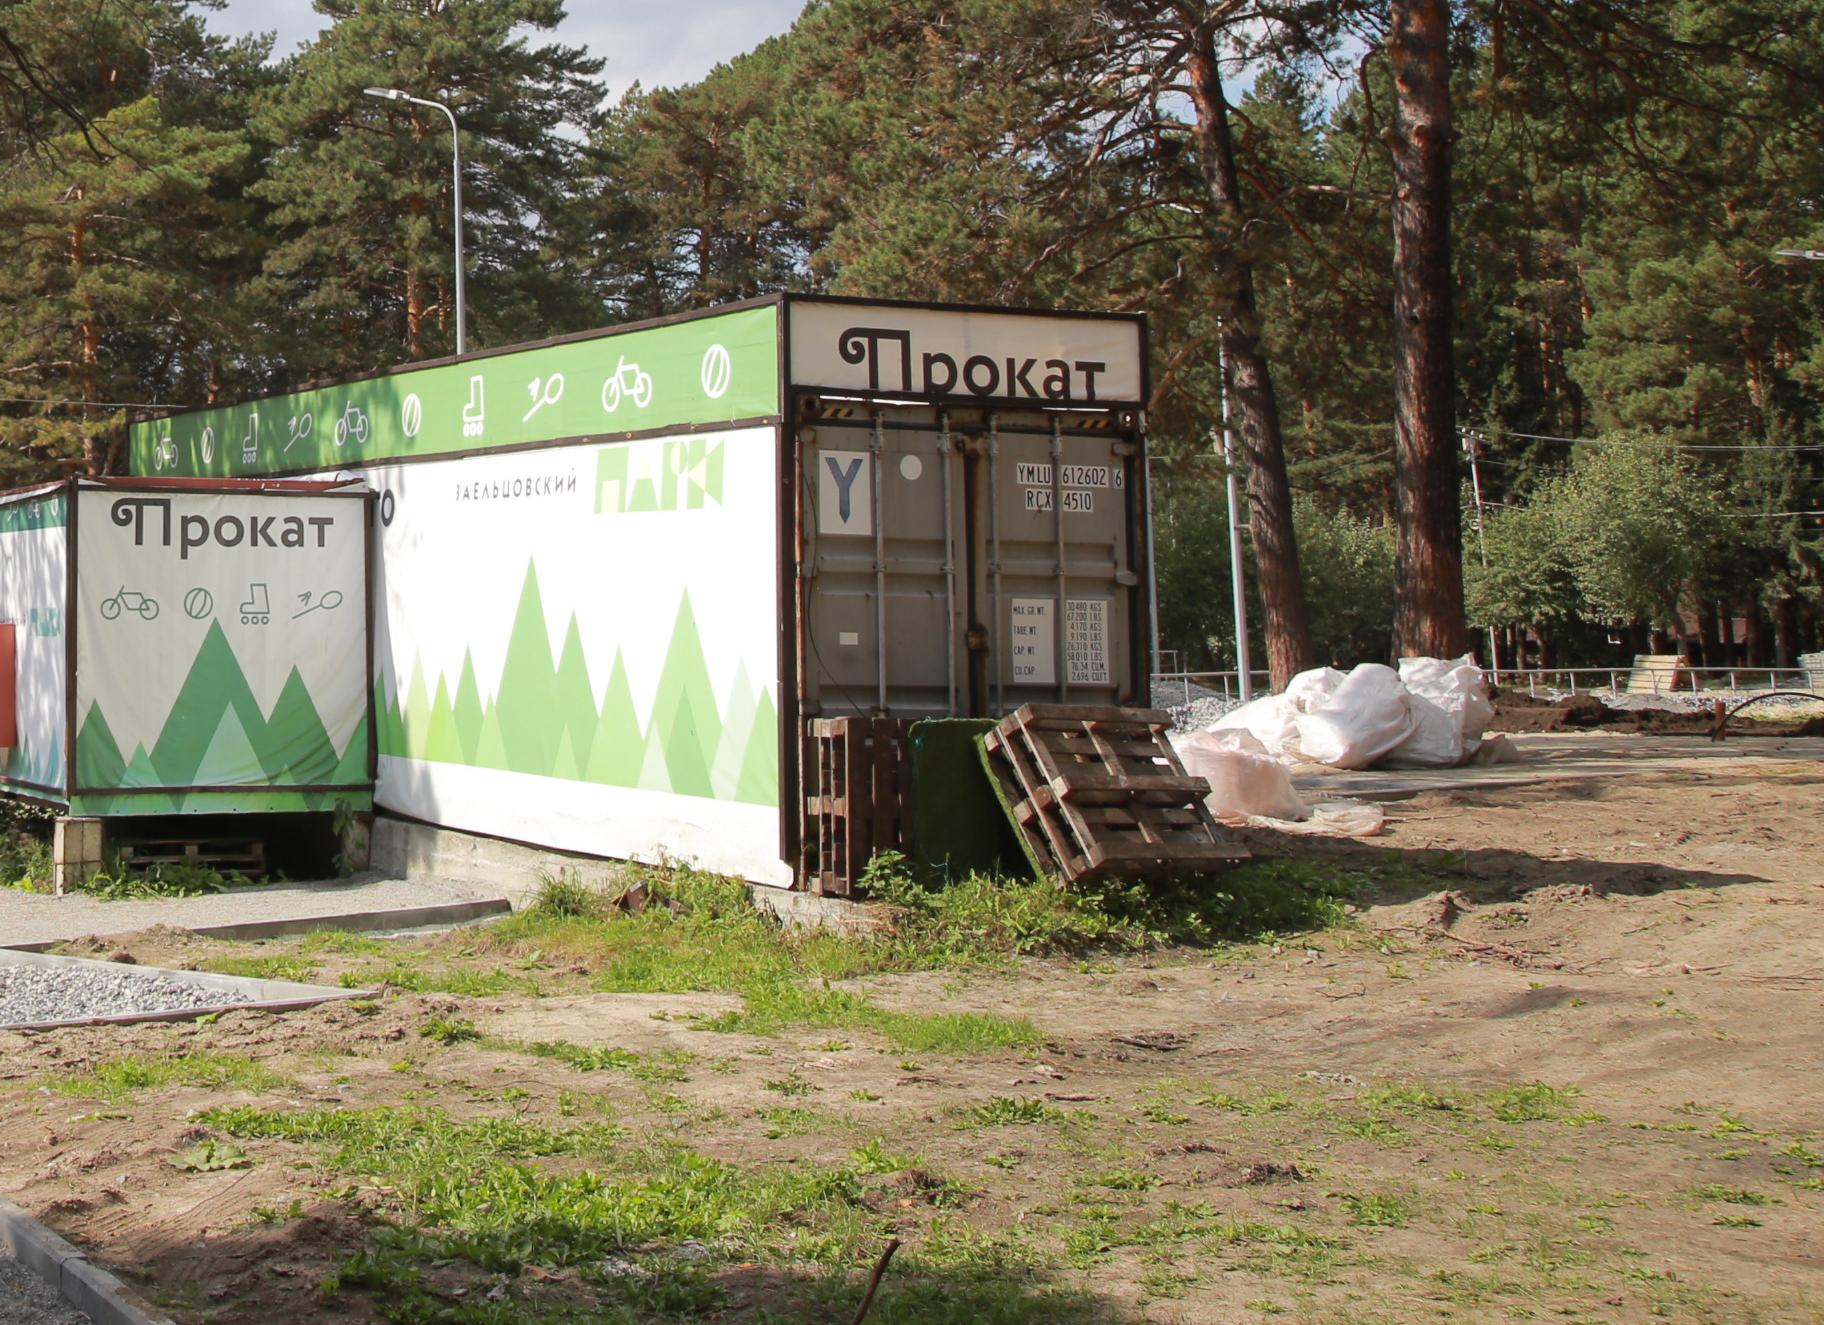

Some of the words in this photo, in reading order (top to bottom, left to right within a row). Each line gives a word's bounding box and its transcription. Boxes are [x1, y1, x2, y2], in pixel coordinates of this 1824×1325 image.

[838, 327, 1106, 400] Прокат
[455, 467, 577, 502] ЗАЕЛЬЦОВСКИЙ
[594, 438, 725, 515] ПАРК
[1018, 465, 1051, 484] YMLU
[1062, 467, 1106, 486] 612602
[1115, 470, 1122, 487] 6
[824, 457, 864, 524] Y
[1027, 490, 1052, 508] RCX
[1063, 492, 1092, 510] 4510
[110, 497, 334, 560] Прокат
[1090, 602, 1102, 612] KGS
[1090, 612, 1102, 622] LBS
[1090, 623, 1102, 632] KGS
[1090, 632, 1102, 641] LBS
[1090, 642, 1102, 652] KGS
[1090, 652, 1103, 661] LBS
